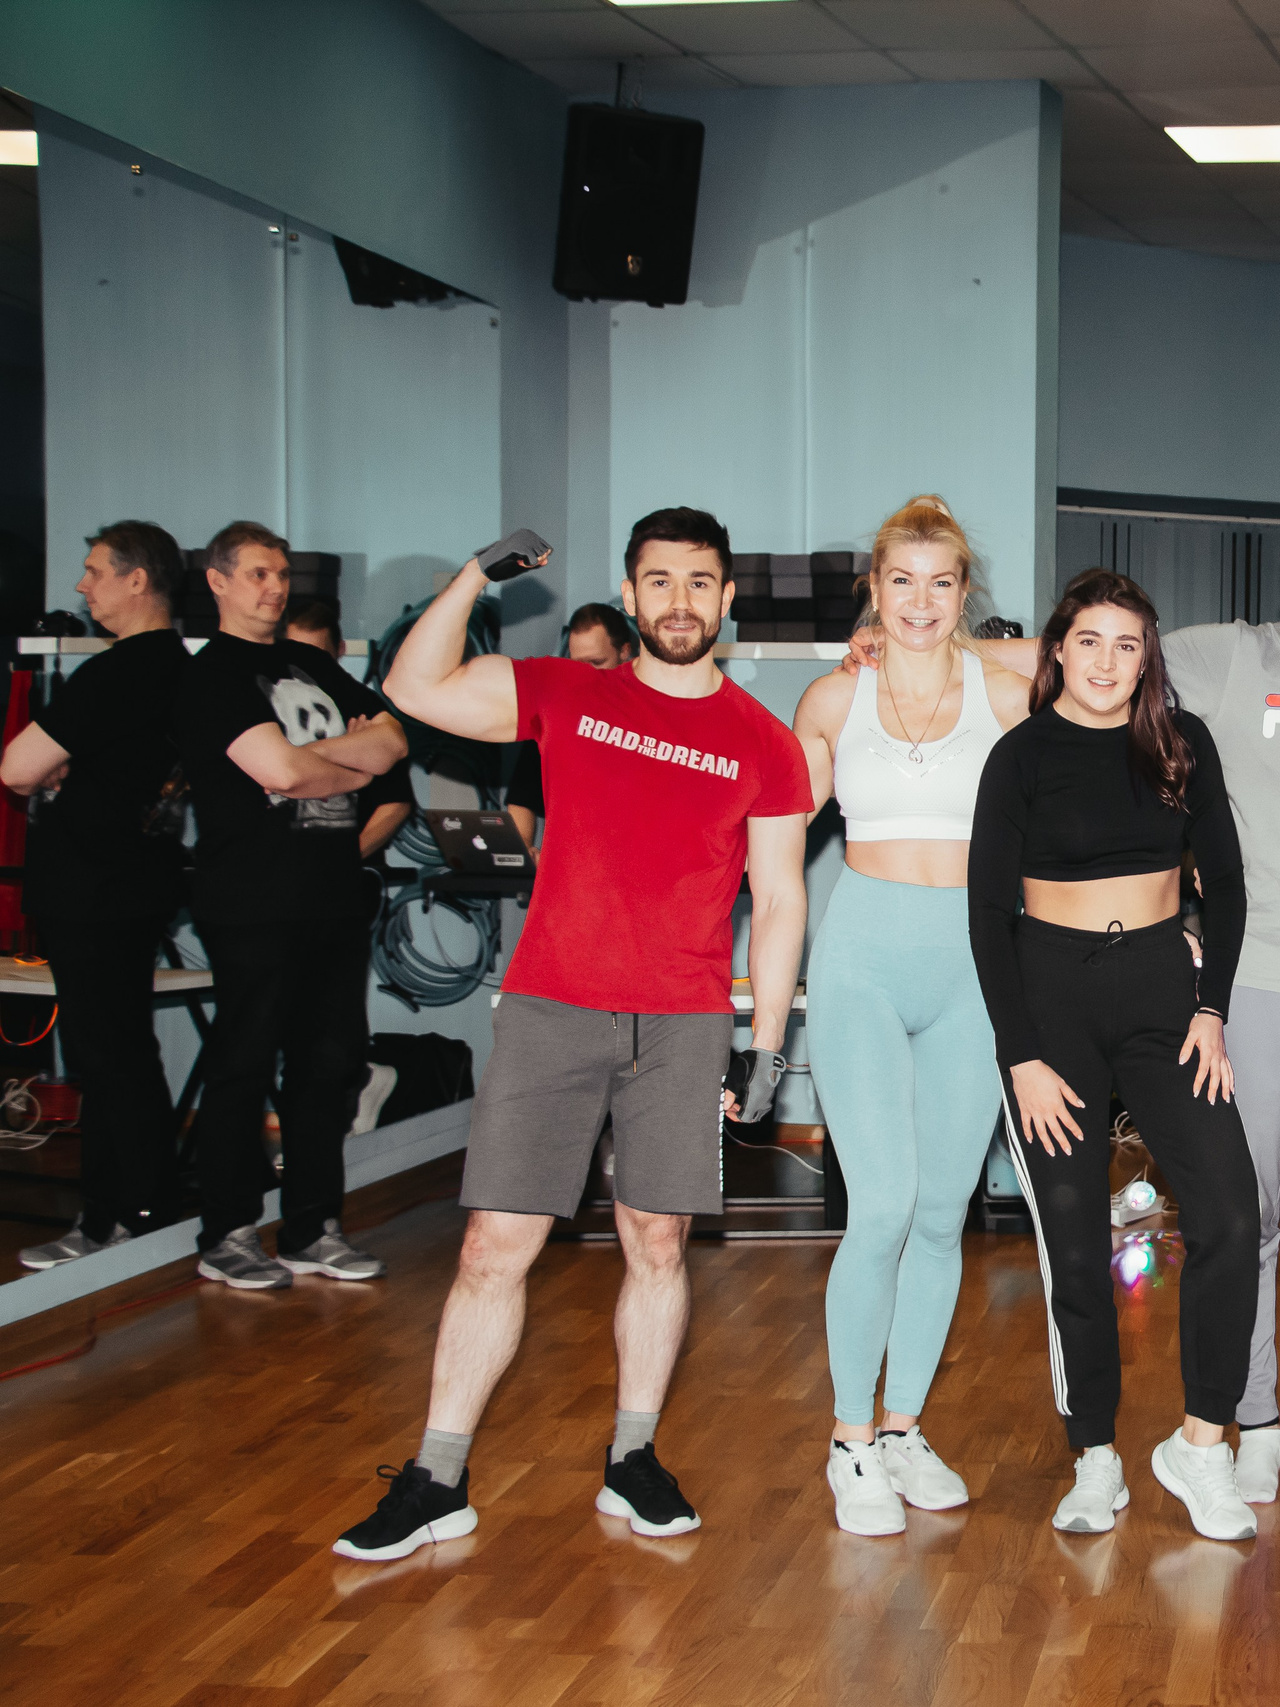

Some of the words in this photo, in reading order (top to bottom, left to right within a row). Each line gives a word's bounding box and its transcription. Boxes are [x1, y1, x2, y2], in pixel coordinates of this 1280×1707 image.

[577, 715, 641, 751] ROAD
[643, 735, 657, 748] TO
[637, 744, 657, 758] THE
[655, 741, 740, 781] DREAM
